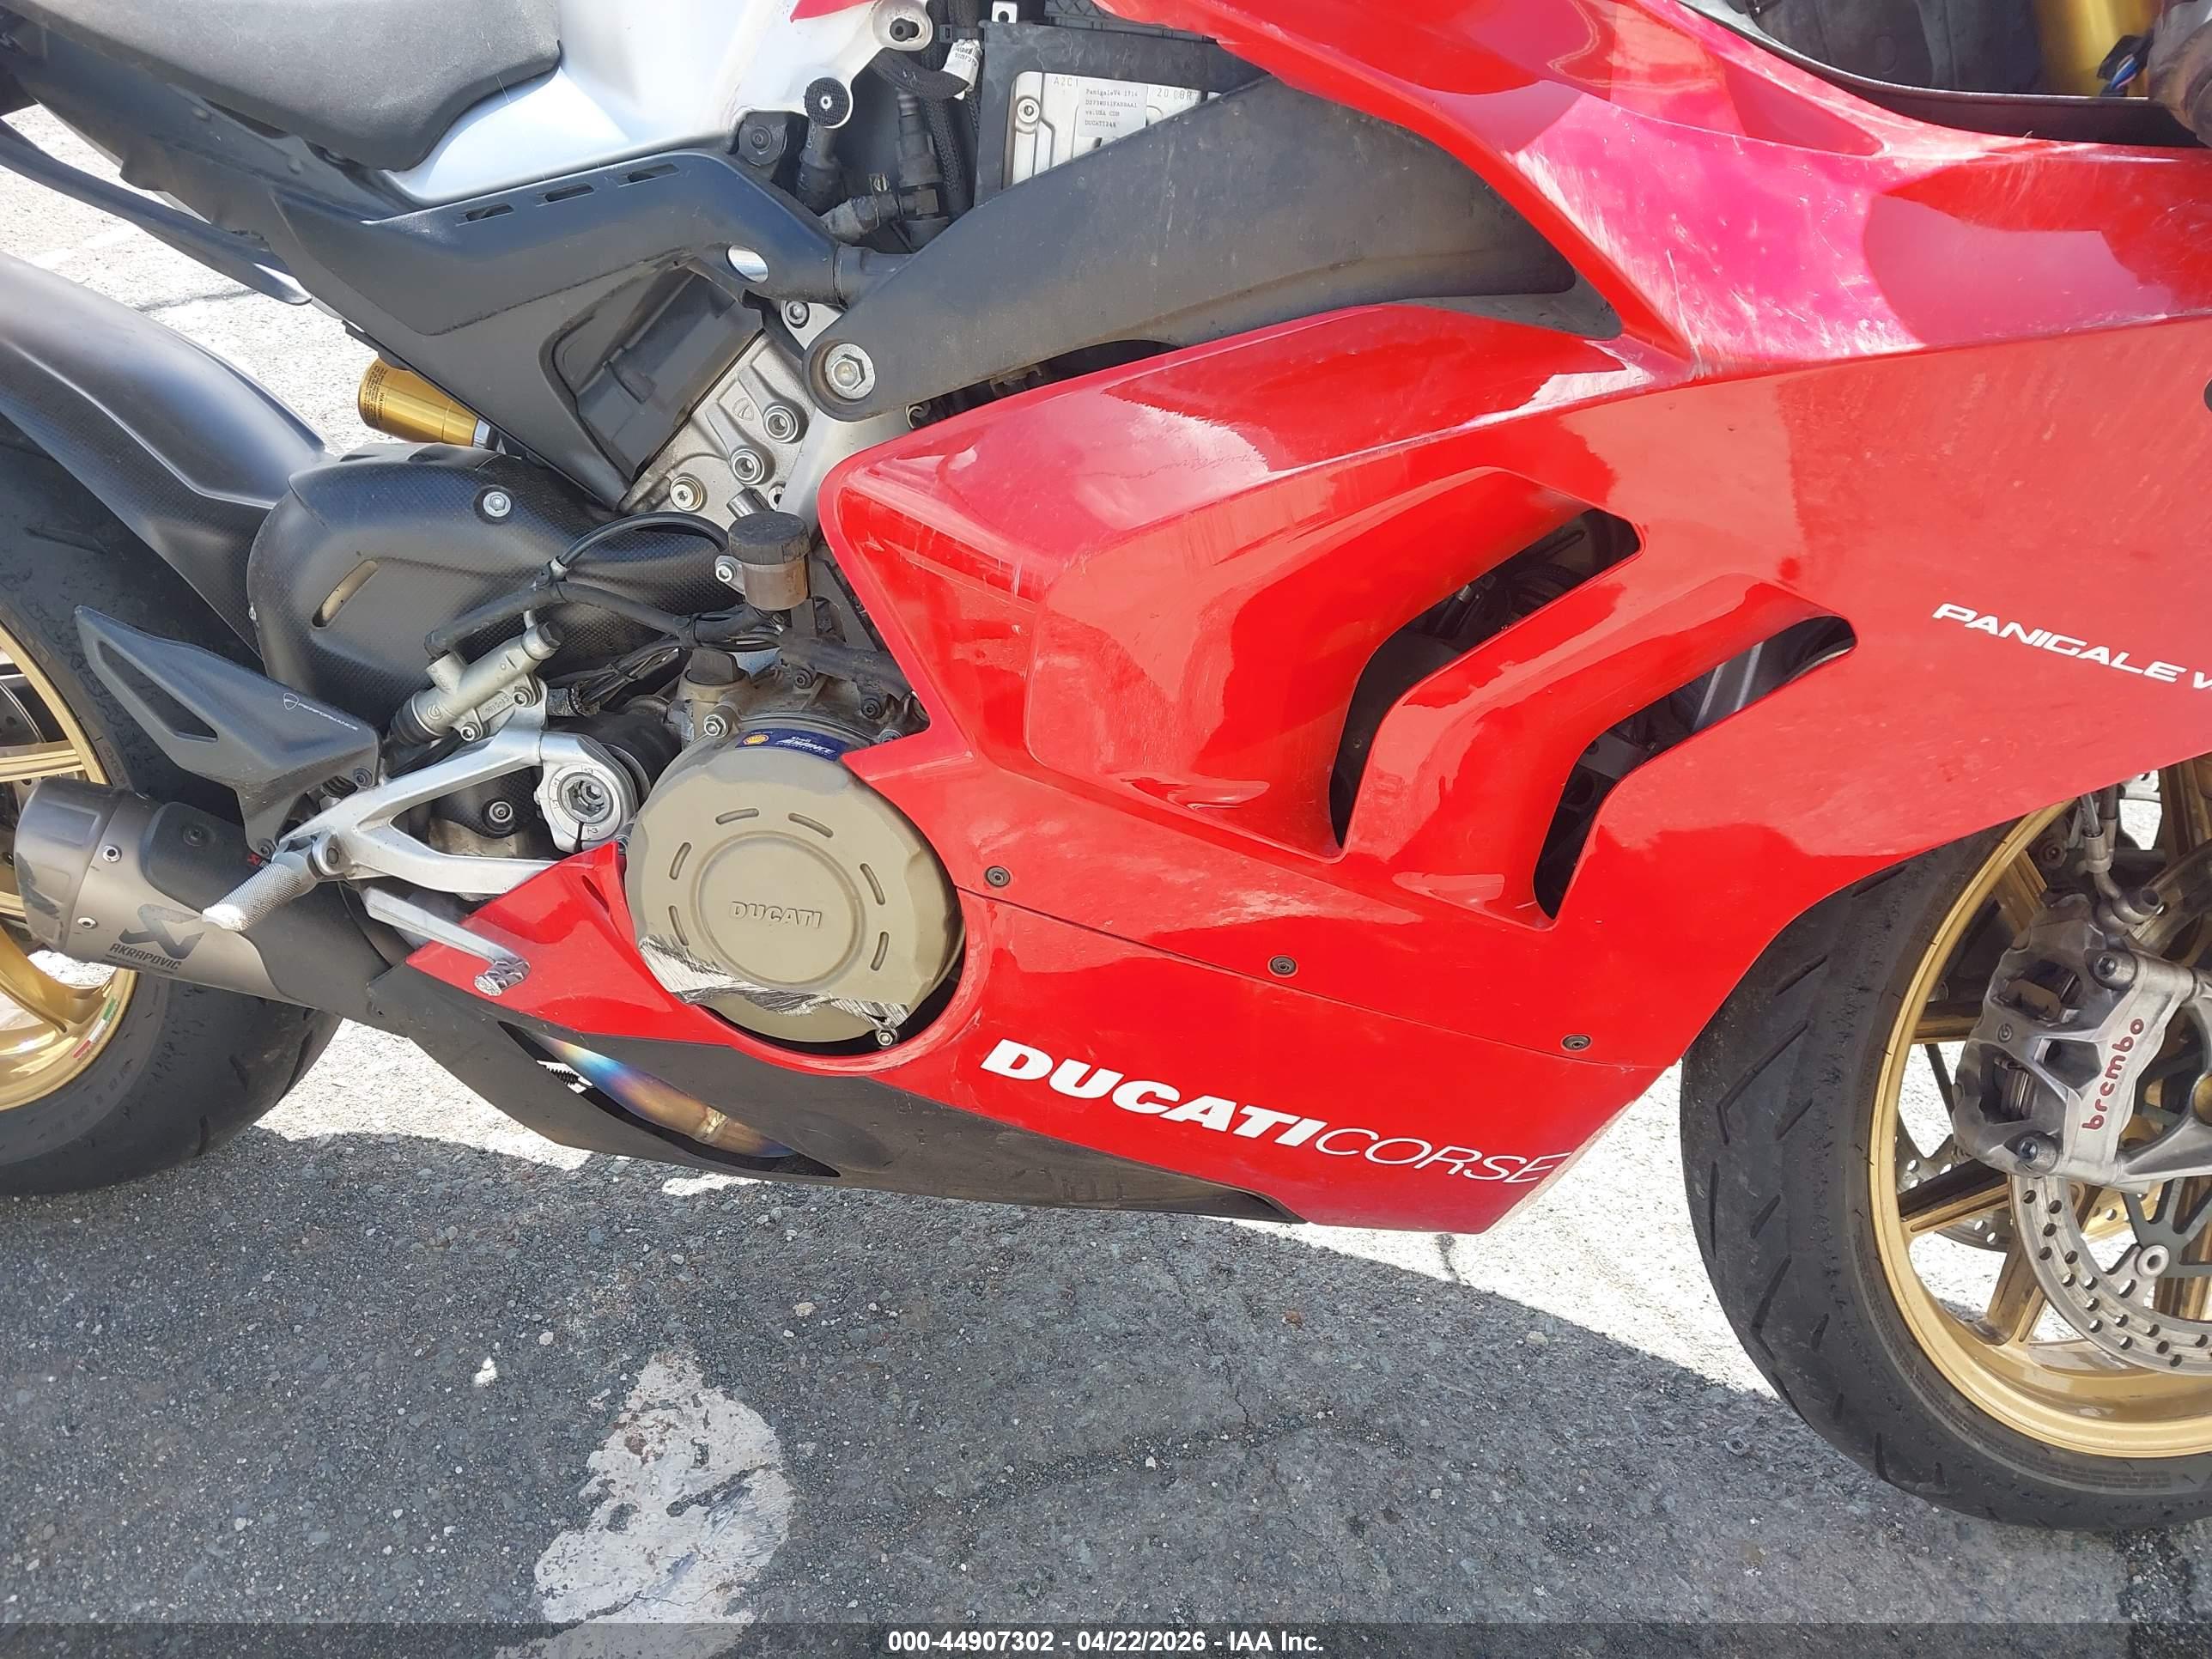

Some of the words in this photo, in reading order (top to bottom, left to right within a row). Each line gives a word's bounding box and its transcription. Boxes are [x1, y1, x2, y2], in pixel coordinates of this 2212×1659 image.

[1932, 603, 2188, 684] PANIGALE
[298, 702, 359, 732] PERFORMANCE
[730, 901, 823, 928] DUCATI
[980, 1037, 1329, 1146] DUCATI
[1315, 1127, 1572, 1184] CORSE
[2081, 1018, 2145, 1130] brembo
